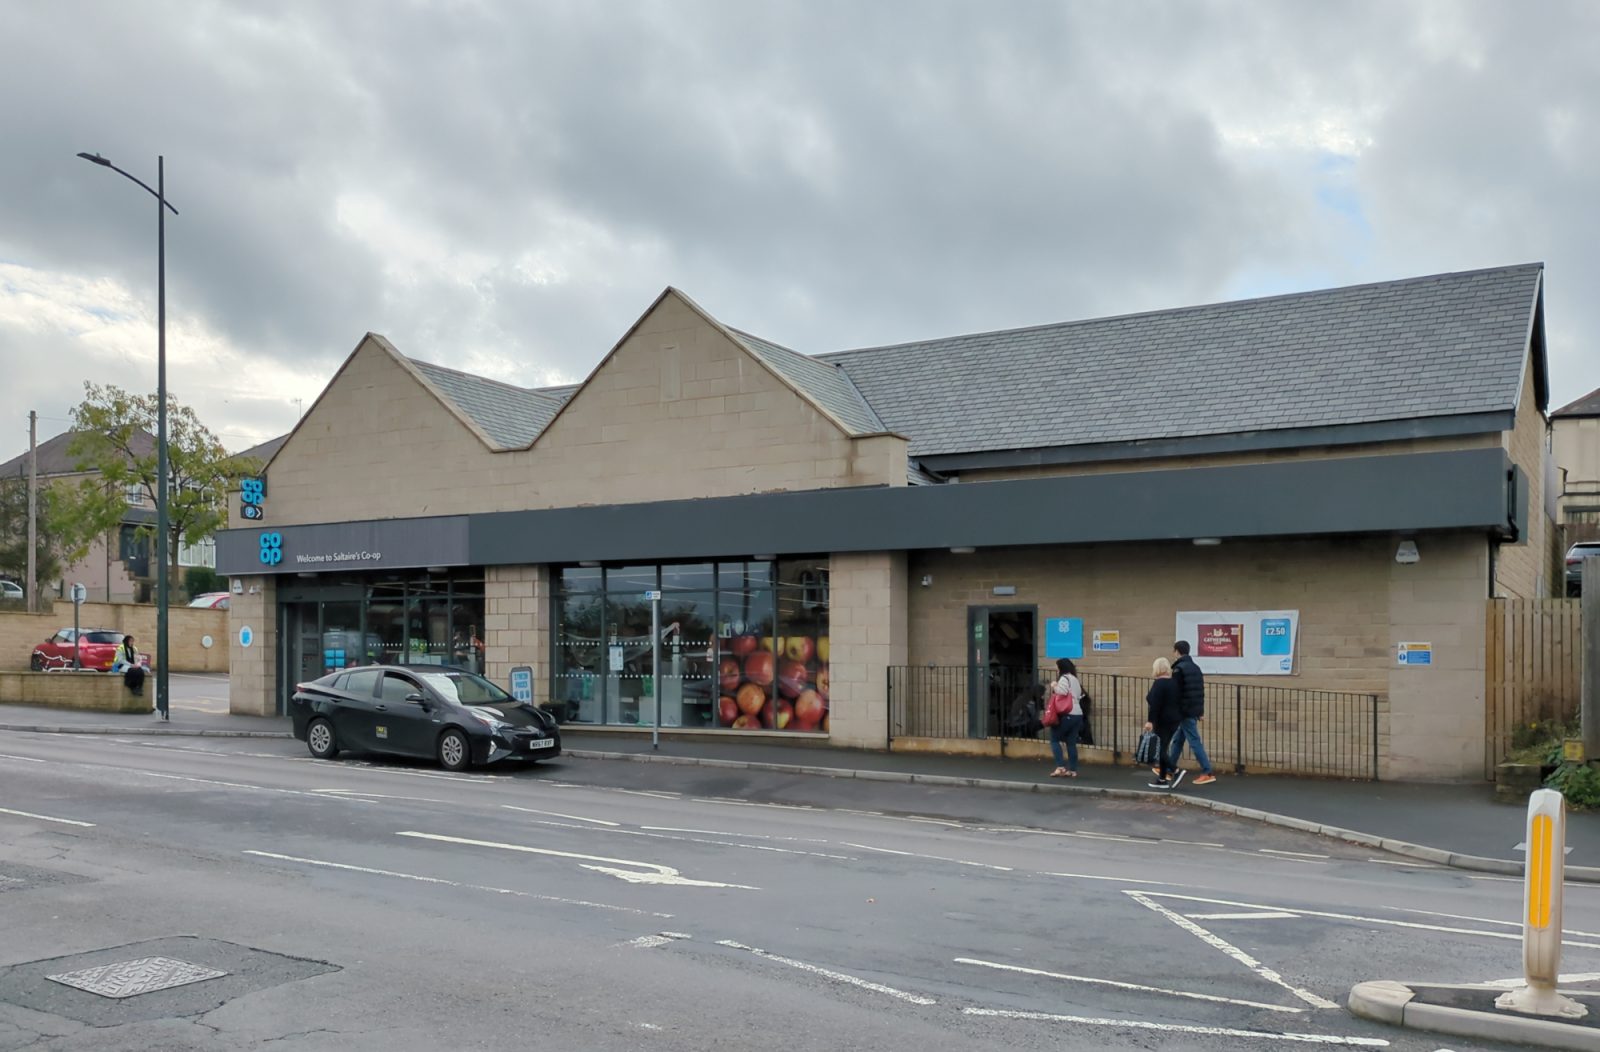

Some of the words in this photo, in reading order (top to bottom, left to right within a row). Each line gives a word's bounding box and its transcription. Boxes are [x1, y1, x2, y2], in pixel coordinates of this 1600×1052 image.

[296, 554, 325, 563] Welcome
[325, 554, 333, 562] to
[333, 551, 361, 561] Saltaire's
[361, 550, 382, 561] Co-op
[1265, 627, 1286, 636] £2.50
